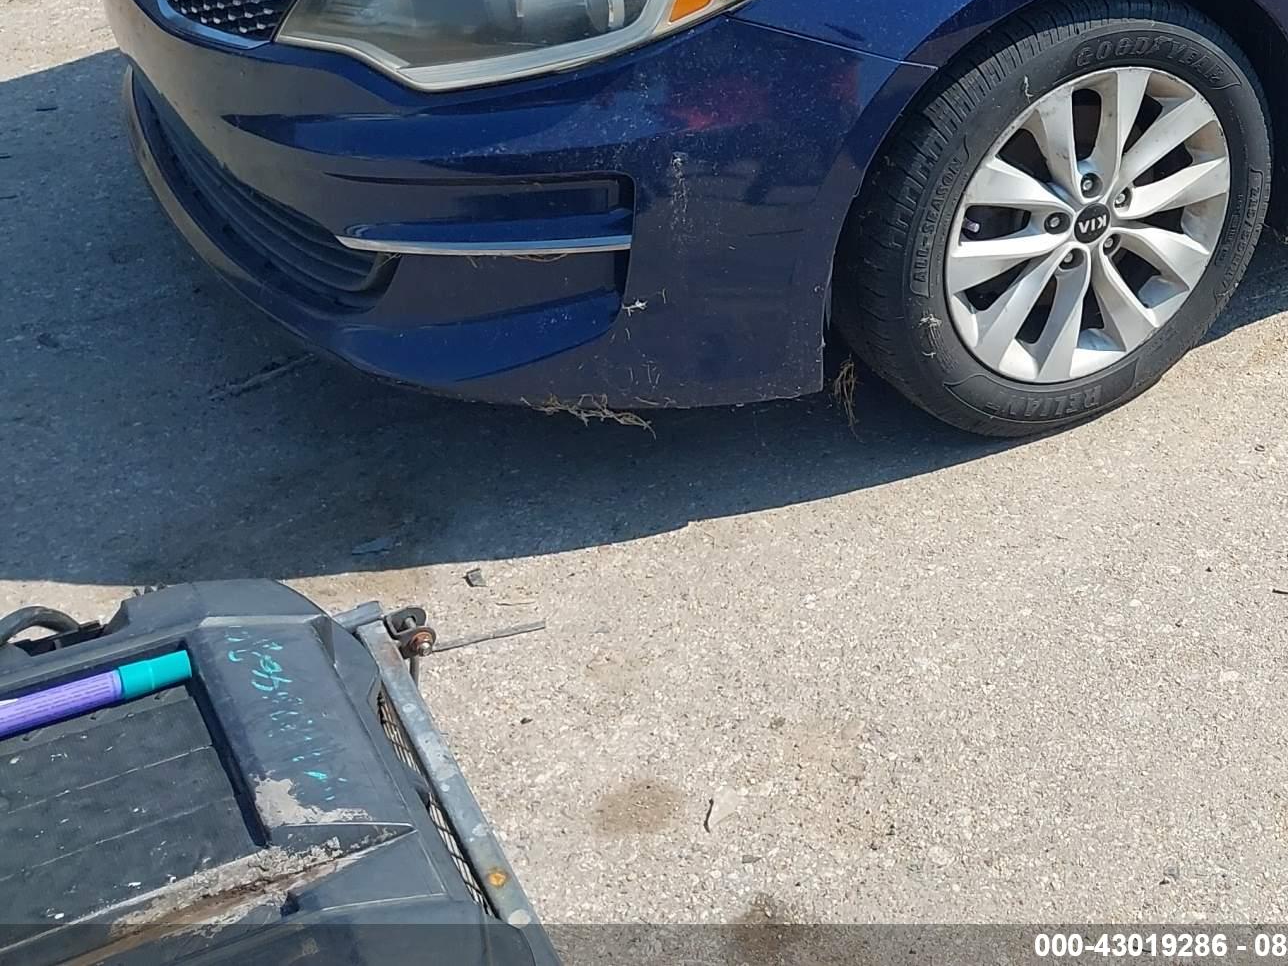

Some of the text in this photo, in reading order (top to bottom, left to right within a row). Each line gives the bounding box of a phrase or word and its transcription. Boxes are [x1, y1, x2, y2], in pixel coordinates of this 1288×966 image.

[1075, 36, 1225, 84] GOODYEAR
[913, 157, 962, 283] ALL-SEASON
[1079, 214, 1107, 234] KIA
